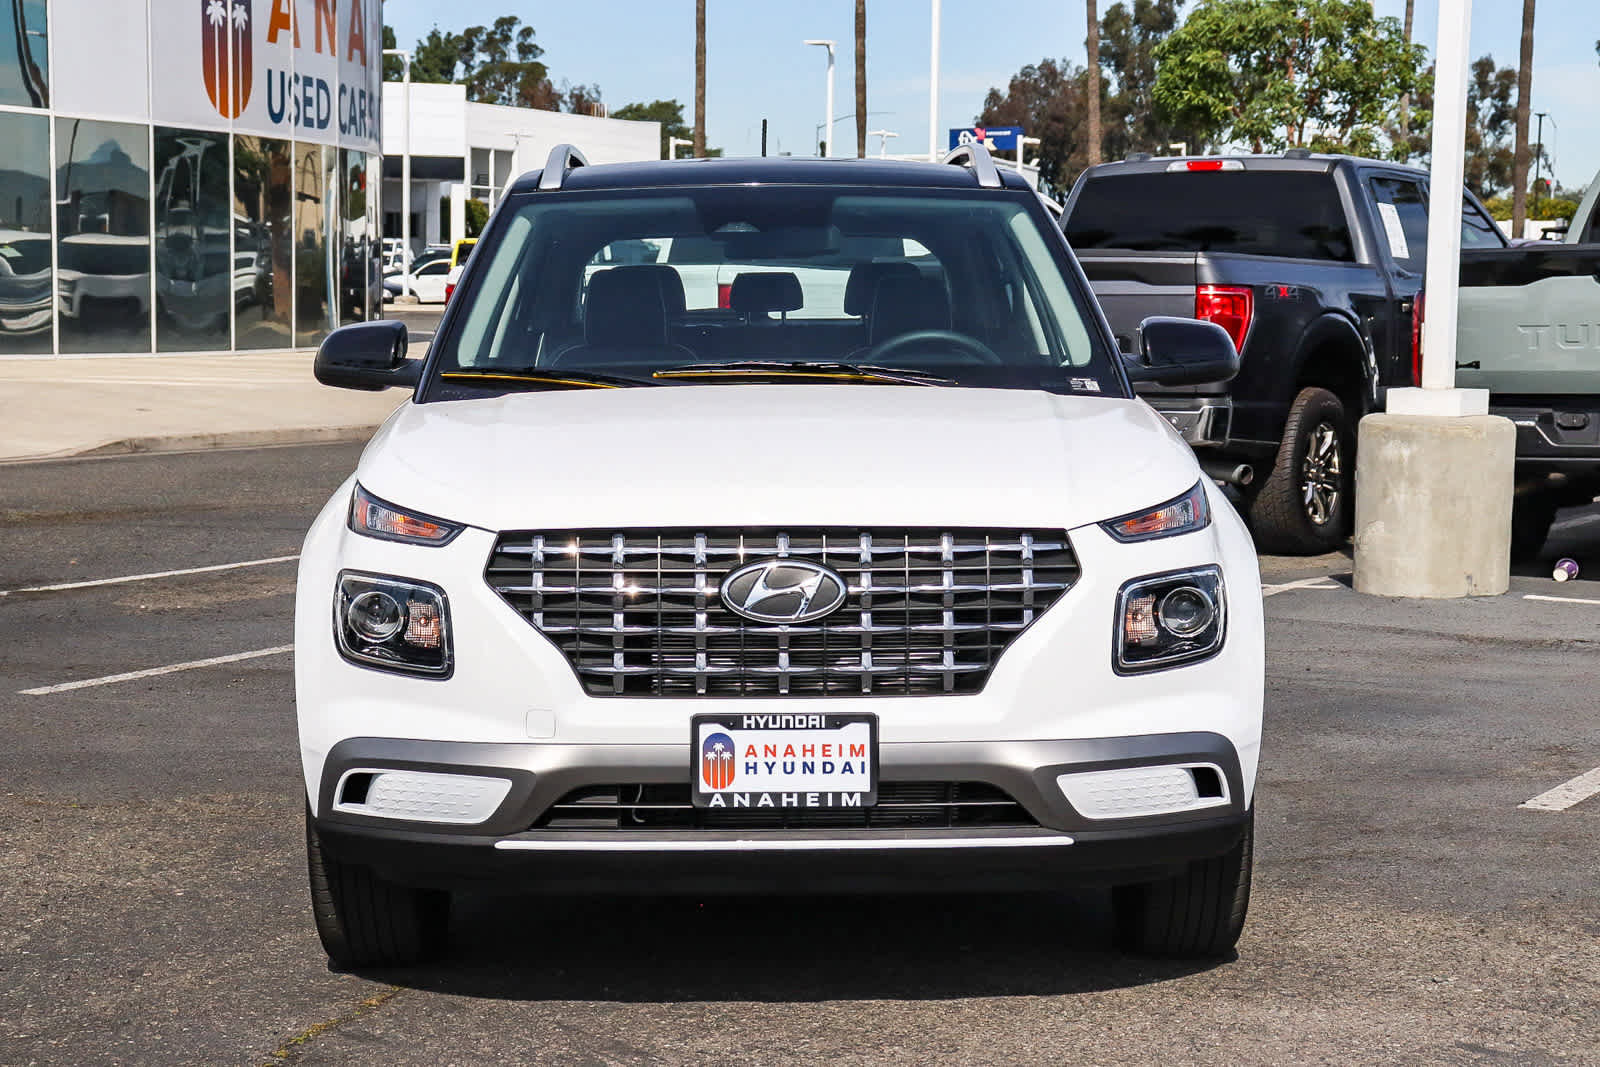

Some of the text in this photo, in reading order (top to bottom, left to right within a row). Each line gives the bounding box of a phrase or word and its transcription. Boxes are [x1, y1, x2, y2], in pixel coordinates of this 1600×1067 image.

[266, 68, 331, 129] USED
[743, 715, 826, 729] HYUNDAI
[744, 743, 866, 758] ANAHEIM
[744, 761, 866, 775] HYUNDAI
[708, 792, 862, 808] ANAHEIM
